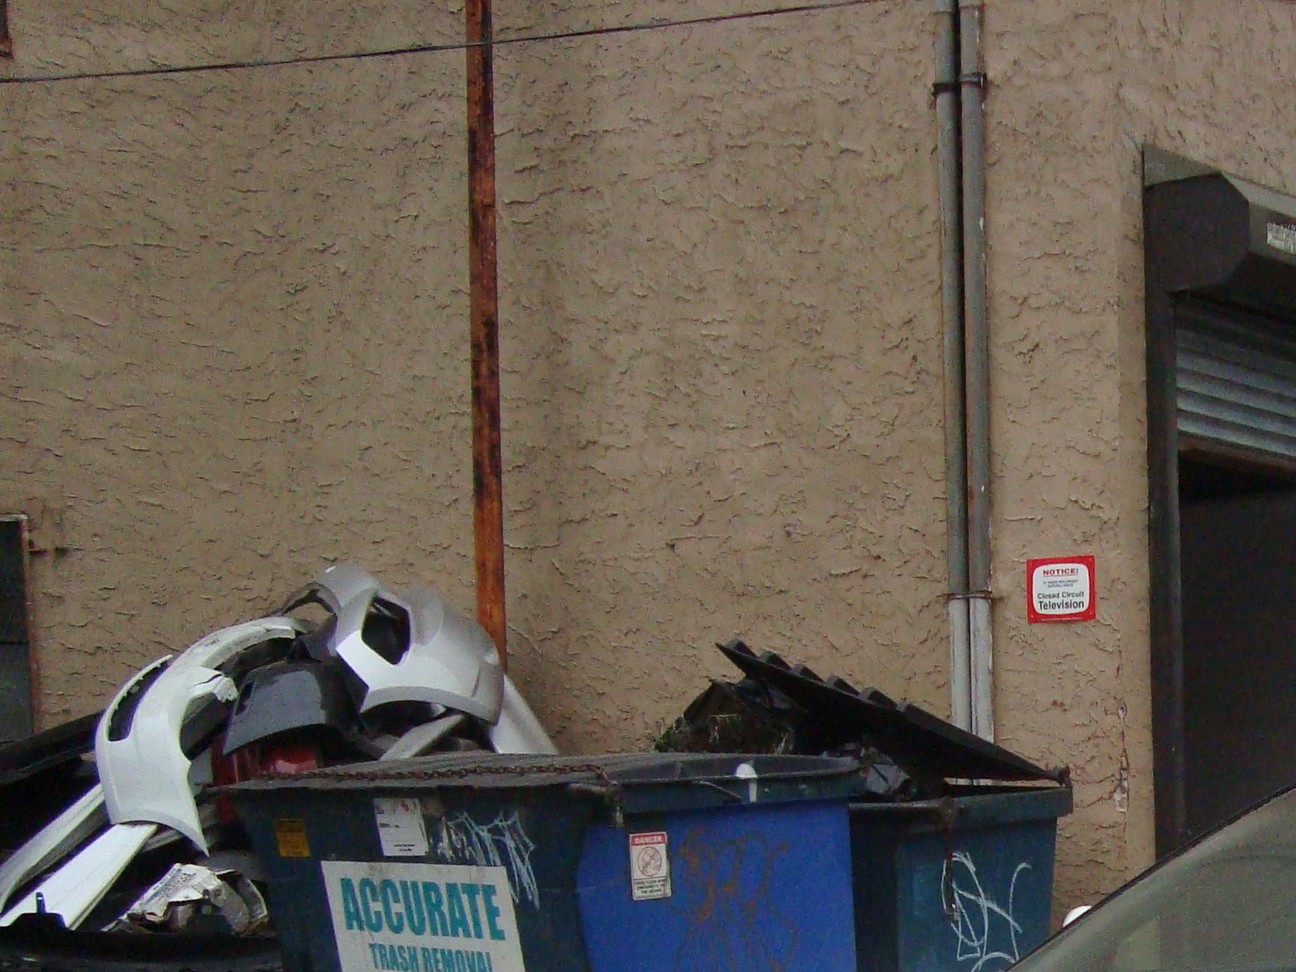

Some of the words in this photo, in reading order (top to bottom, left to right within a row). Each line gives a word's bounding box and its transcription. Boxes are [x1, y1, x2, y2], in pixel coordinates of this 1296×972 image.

[1043, 568, 1079, 576] NOTICE!
[1038, 599, 1084, 610] Television
[340, 877, 506, 941] ACCURATE
[368, 943, 419, 972] TRASH
